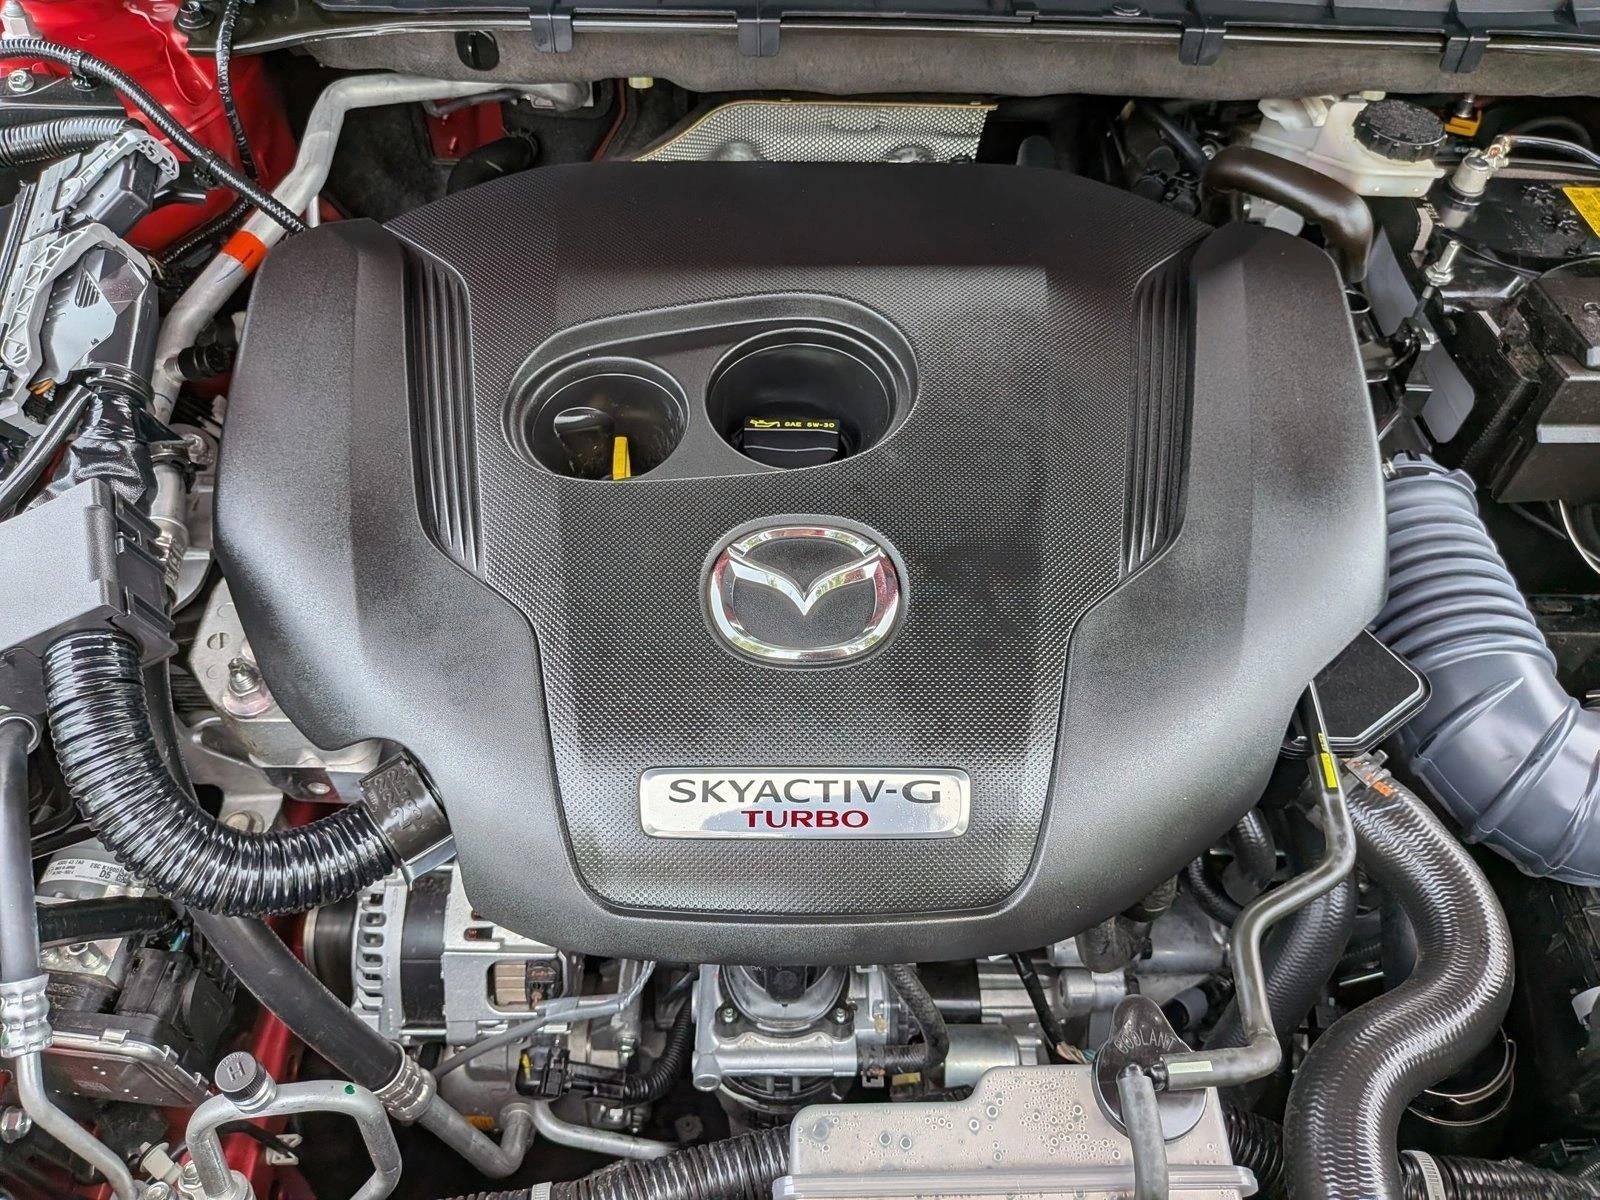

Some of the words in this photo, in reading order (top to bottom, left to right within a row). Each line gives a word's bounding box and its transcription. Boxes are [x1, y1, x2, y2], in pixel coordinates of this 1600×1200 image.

[668, 779, 942, 804] SKYACTIV-G
[741, 810, 870, 829] TURBO
[1114, 1028, 1178, 1055] COOLANT
[226, 1061, 246, 1083] H
